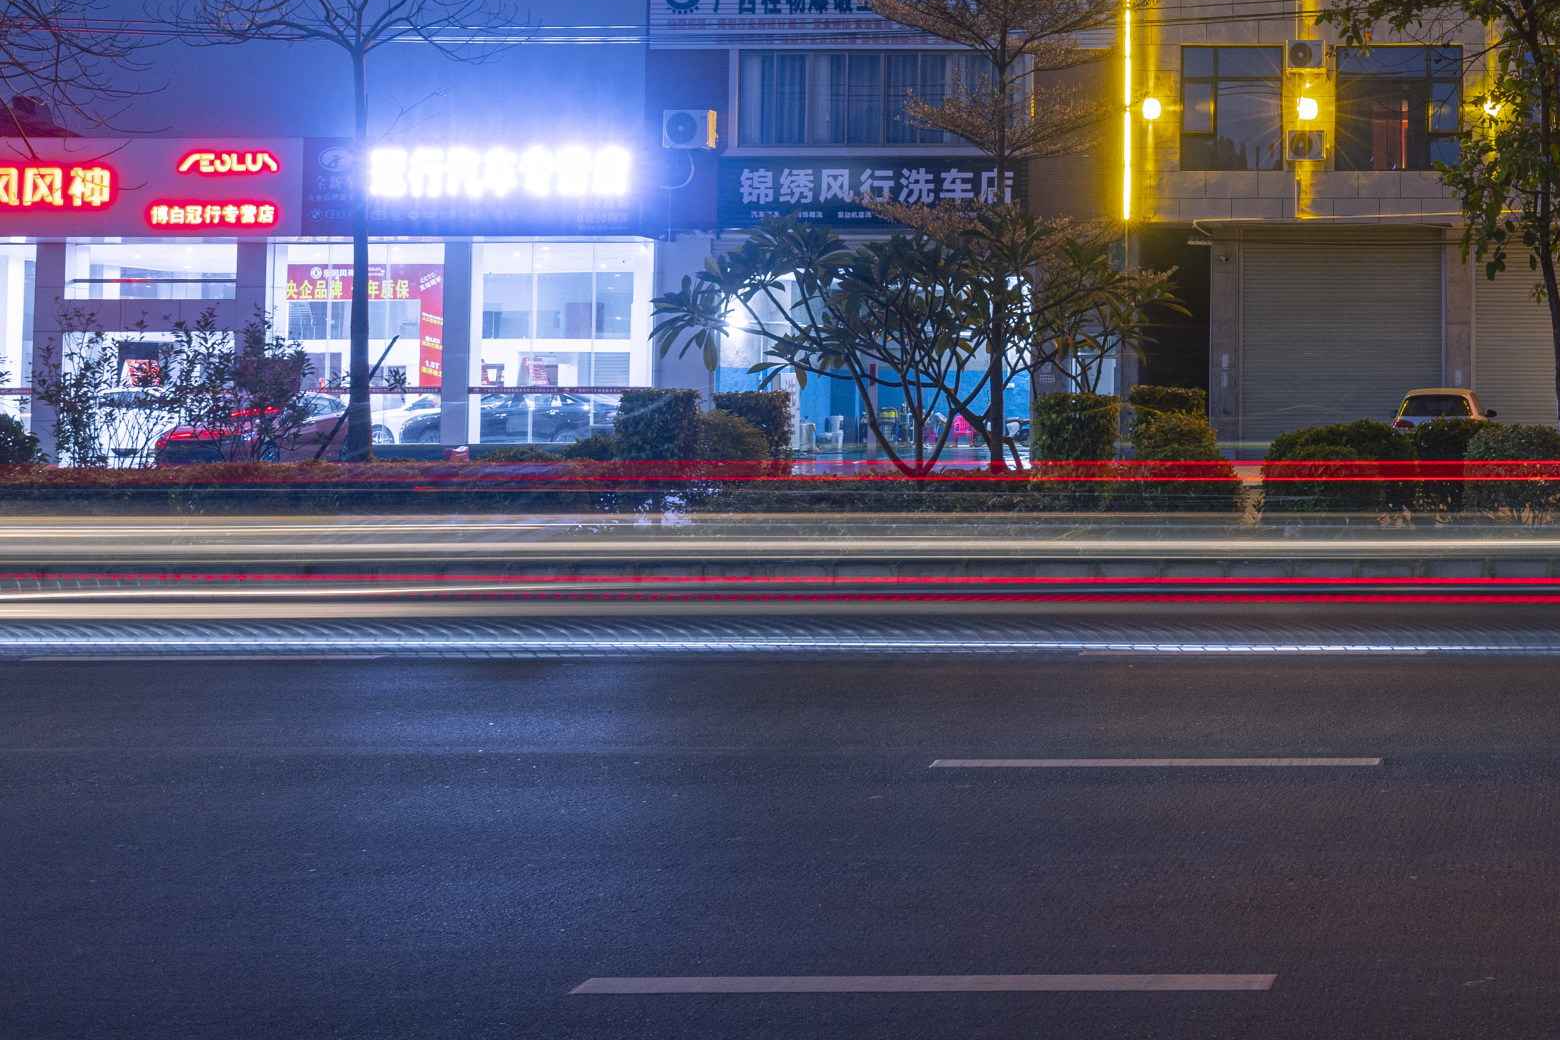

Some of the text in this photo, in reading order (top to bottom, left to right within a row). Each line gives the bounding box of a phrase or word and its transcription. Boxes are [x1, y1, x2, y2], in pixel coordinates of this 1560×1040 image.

[740, 167, 1014, 205] 锦绣风行洗车店
[150, 204, 275, 225] 博白冠行专营店
[351, 279, 410, 299] 年质保
